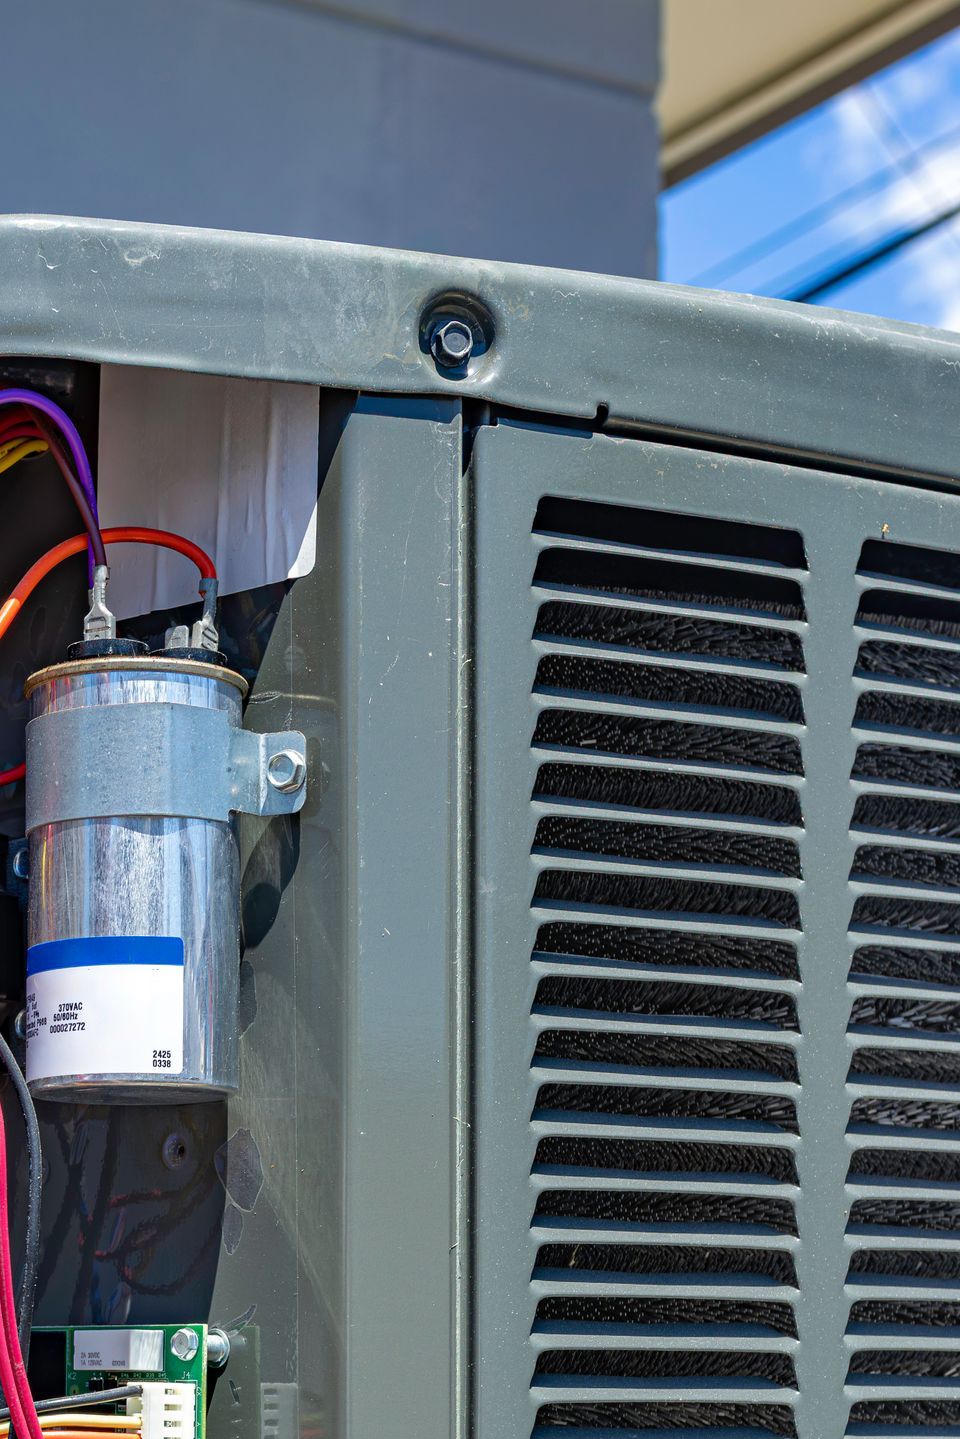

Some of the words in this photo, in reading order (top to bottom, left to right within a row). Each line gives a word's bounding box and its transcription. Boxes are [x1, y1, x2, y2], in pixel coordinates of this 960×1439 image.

[59, 1002, 83, 1012] 370VAC
[153, 1050, 172, 1059] 2425
[153, 1059, 172, 1068] 0338
[182, 1372, 190, 1380] J4
